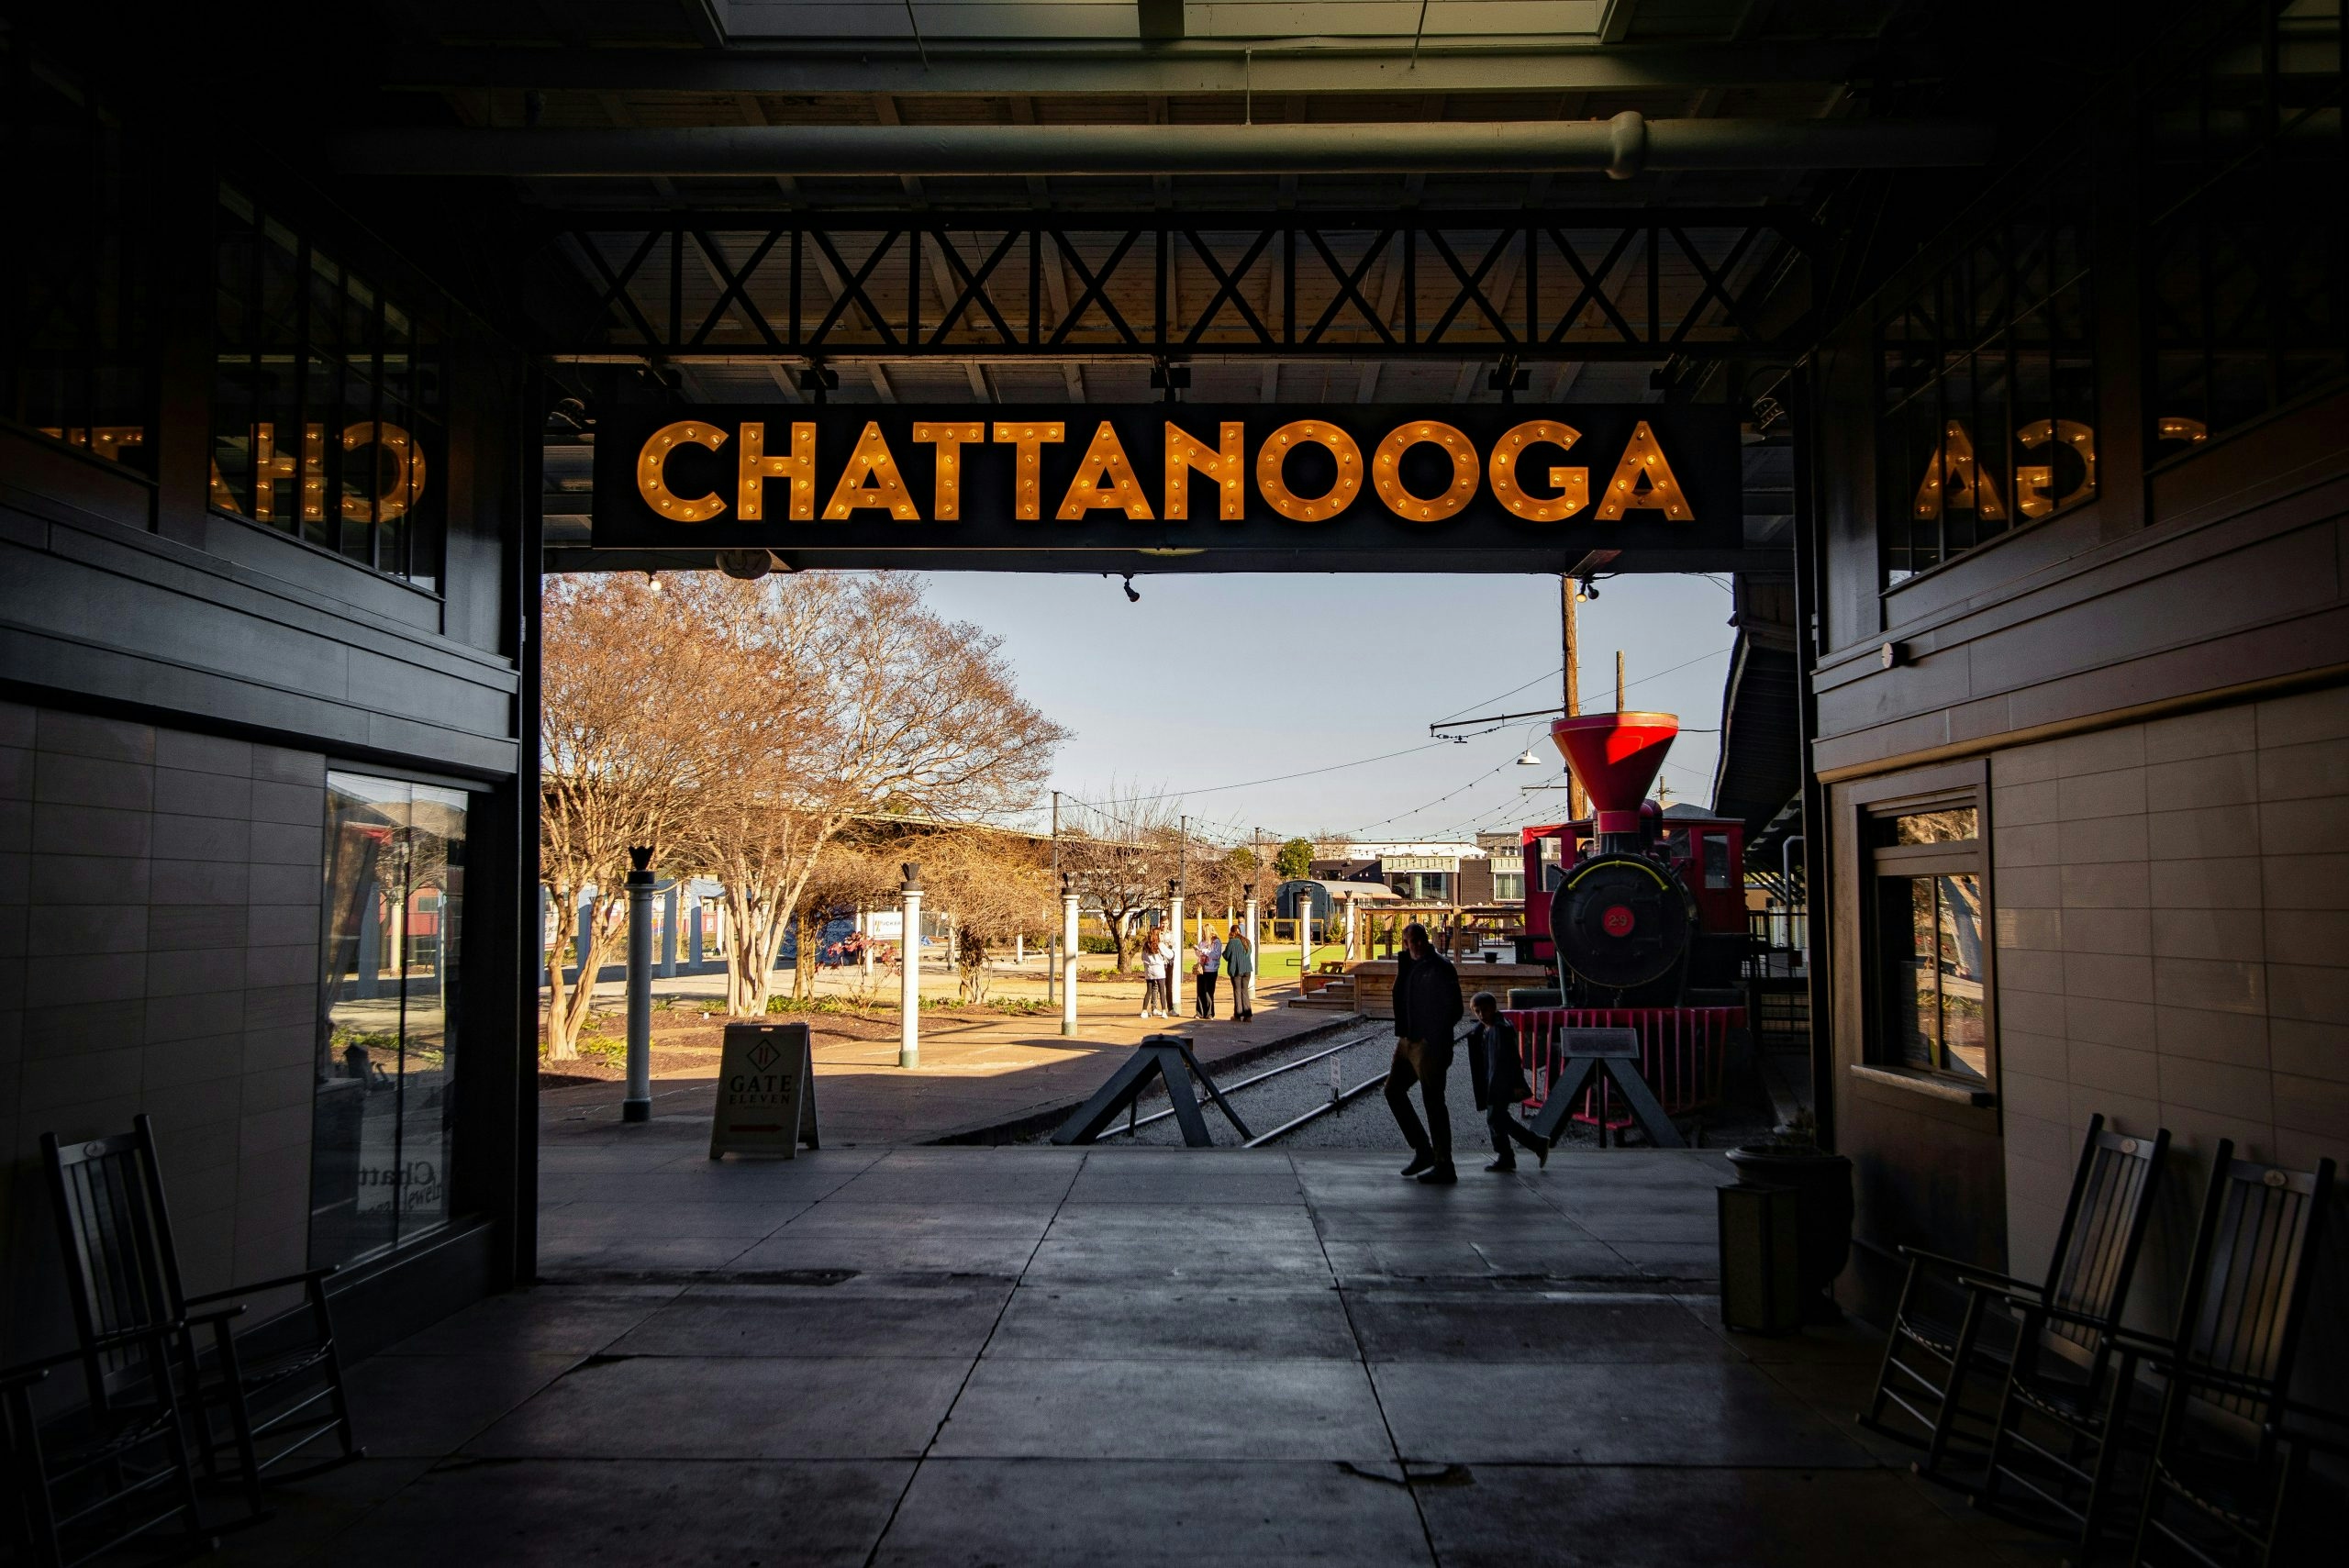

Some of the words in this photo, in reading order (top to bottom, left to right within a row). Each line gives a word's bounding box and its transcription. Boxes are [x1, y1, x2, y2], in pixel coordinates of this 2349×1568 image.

[637, 419, 1695, 522] CHATTANOOGA
[1609, 914, 1628, 927] 29
[730, 1074, 793, 1093] GATE
[729, 1094, 790, 1105] ELEVEN
